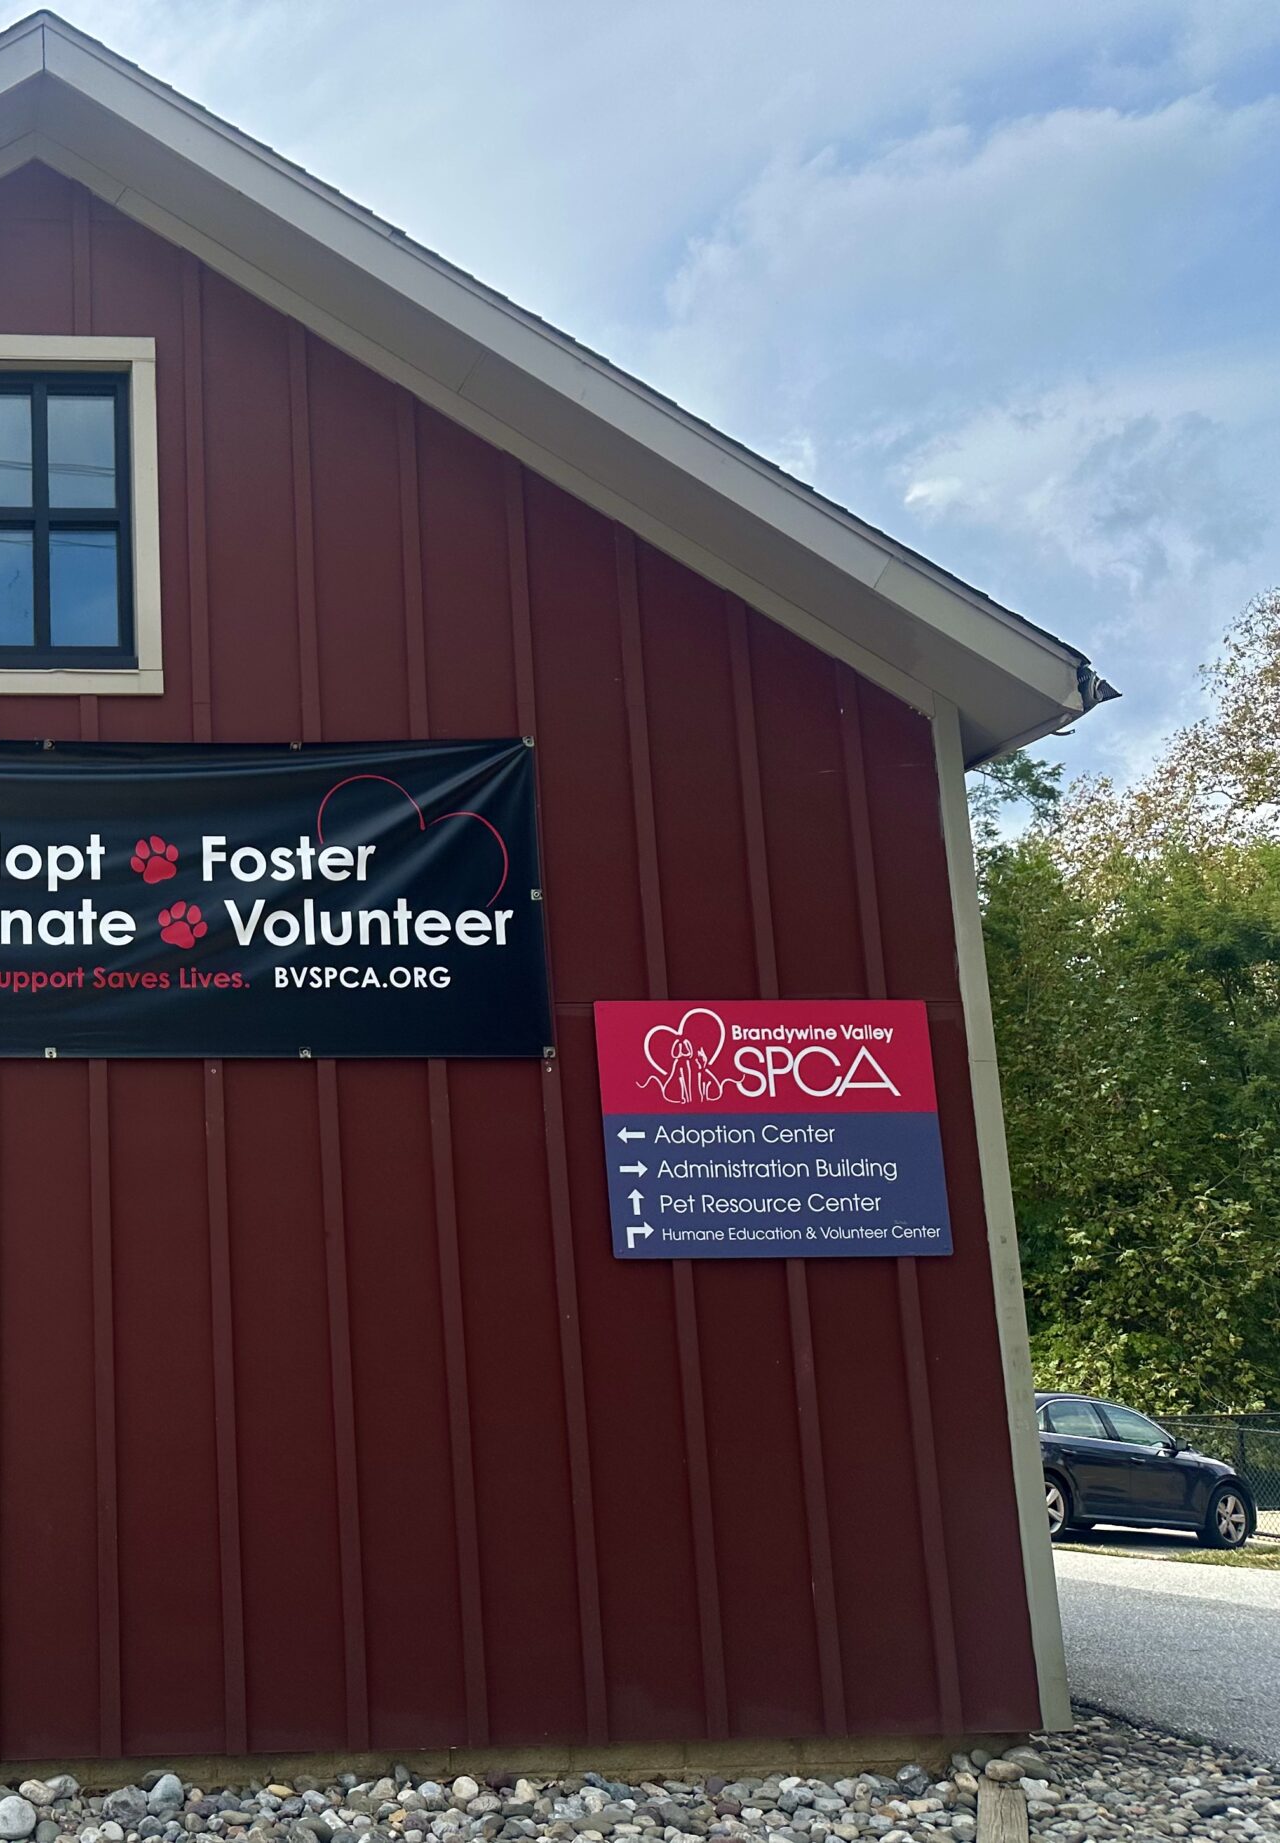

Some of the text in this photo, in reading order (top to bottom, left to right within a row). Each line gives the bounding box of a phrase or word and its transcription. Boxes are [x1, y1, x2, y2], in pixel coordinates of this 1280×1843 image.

[201, 835, 376, 883] Foster
[224, 898, 514, 947] Volunteer
[92, 966, 170, 989] Saves
[179, 967, 251, 989] Lives.
[273, 966, 451, 989] BVSPCA.ORG
[732, 1024, 893, 1043] Brandywine Valley
[733, 1046, 901, 1098] SPCA
[654, 1124, 835, 1147] Adoption Center
[657, 1159, 898, 1180] Administration Building
[660, 1193, 881, 1214] Pet Resource Center
[662, 1225, 941, 1241] Humane Education & Volunteer Center
